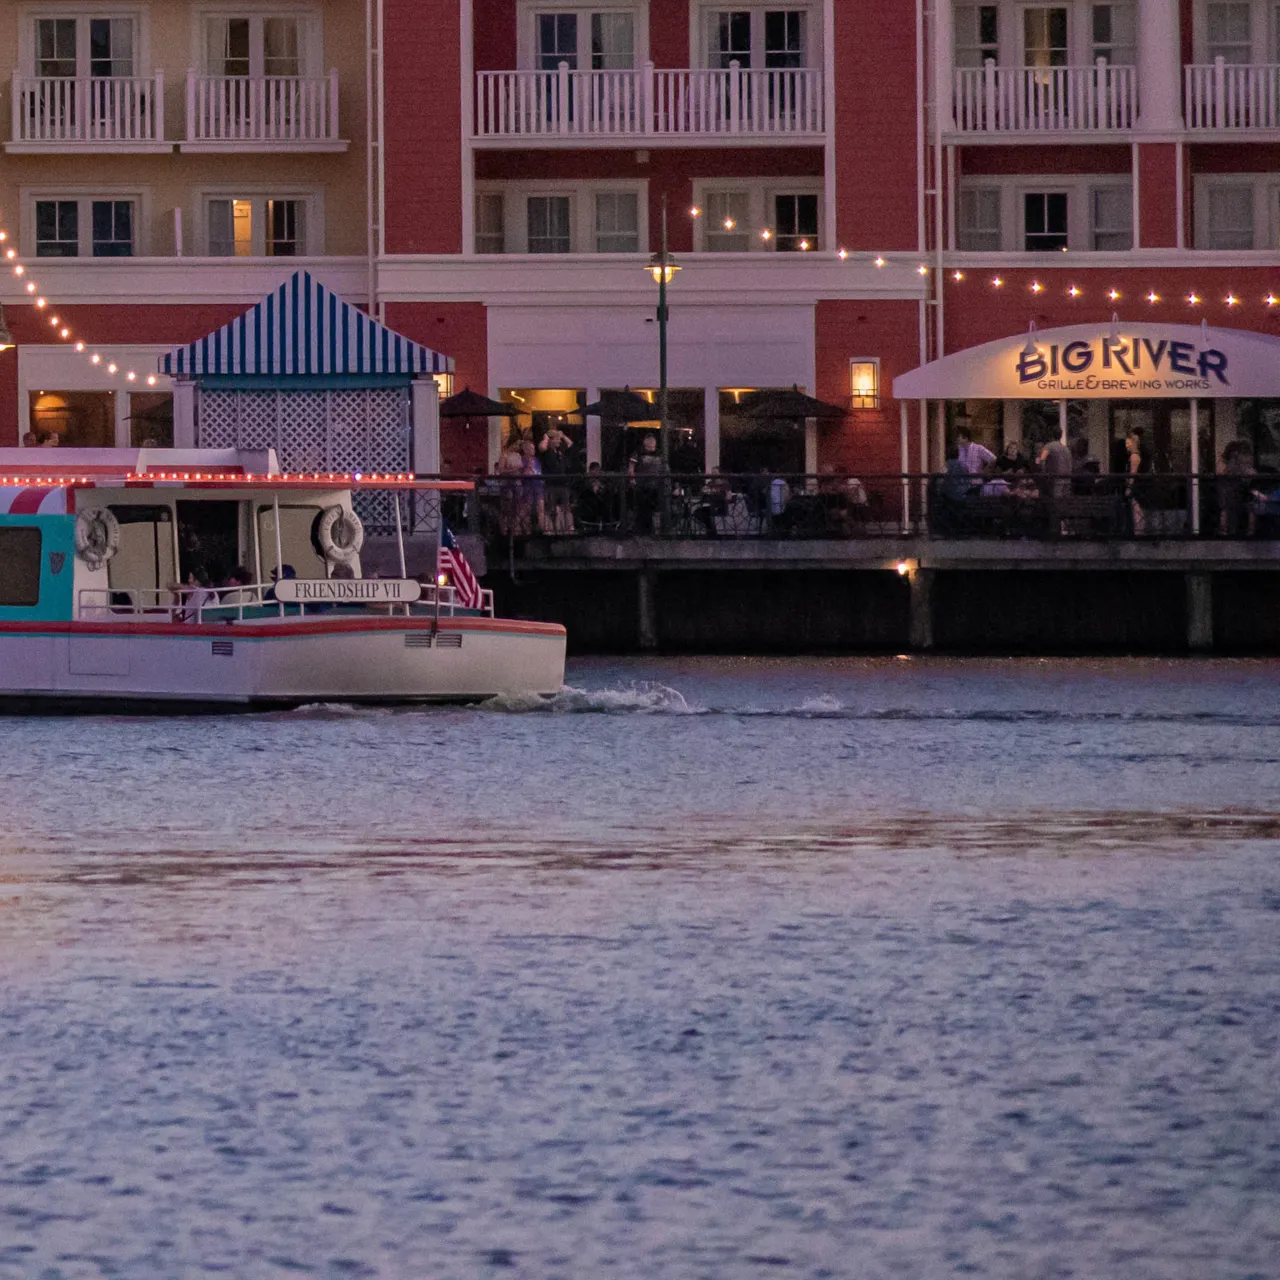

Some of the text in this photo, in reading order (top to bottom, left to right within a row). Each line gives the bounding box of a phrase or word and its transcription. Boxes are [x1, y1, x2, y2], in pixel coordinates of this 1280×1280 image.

[1015, 337, 1230, 386] BIG RIVER
[1037, 379, 1086, 390] GRILLE
[1101, 379, 1162, 390] BREWING
[294, 582, 401, 599] FRIENDSHIP VII
